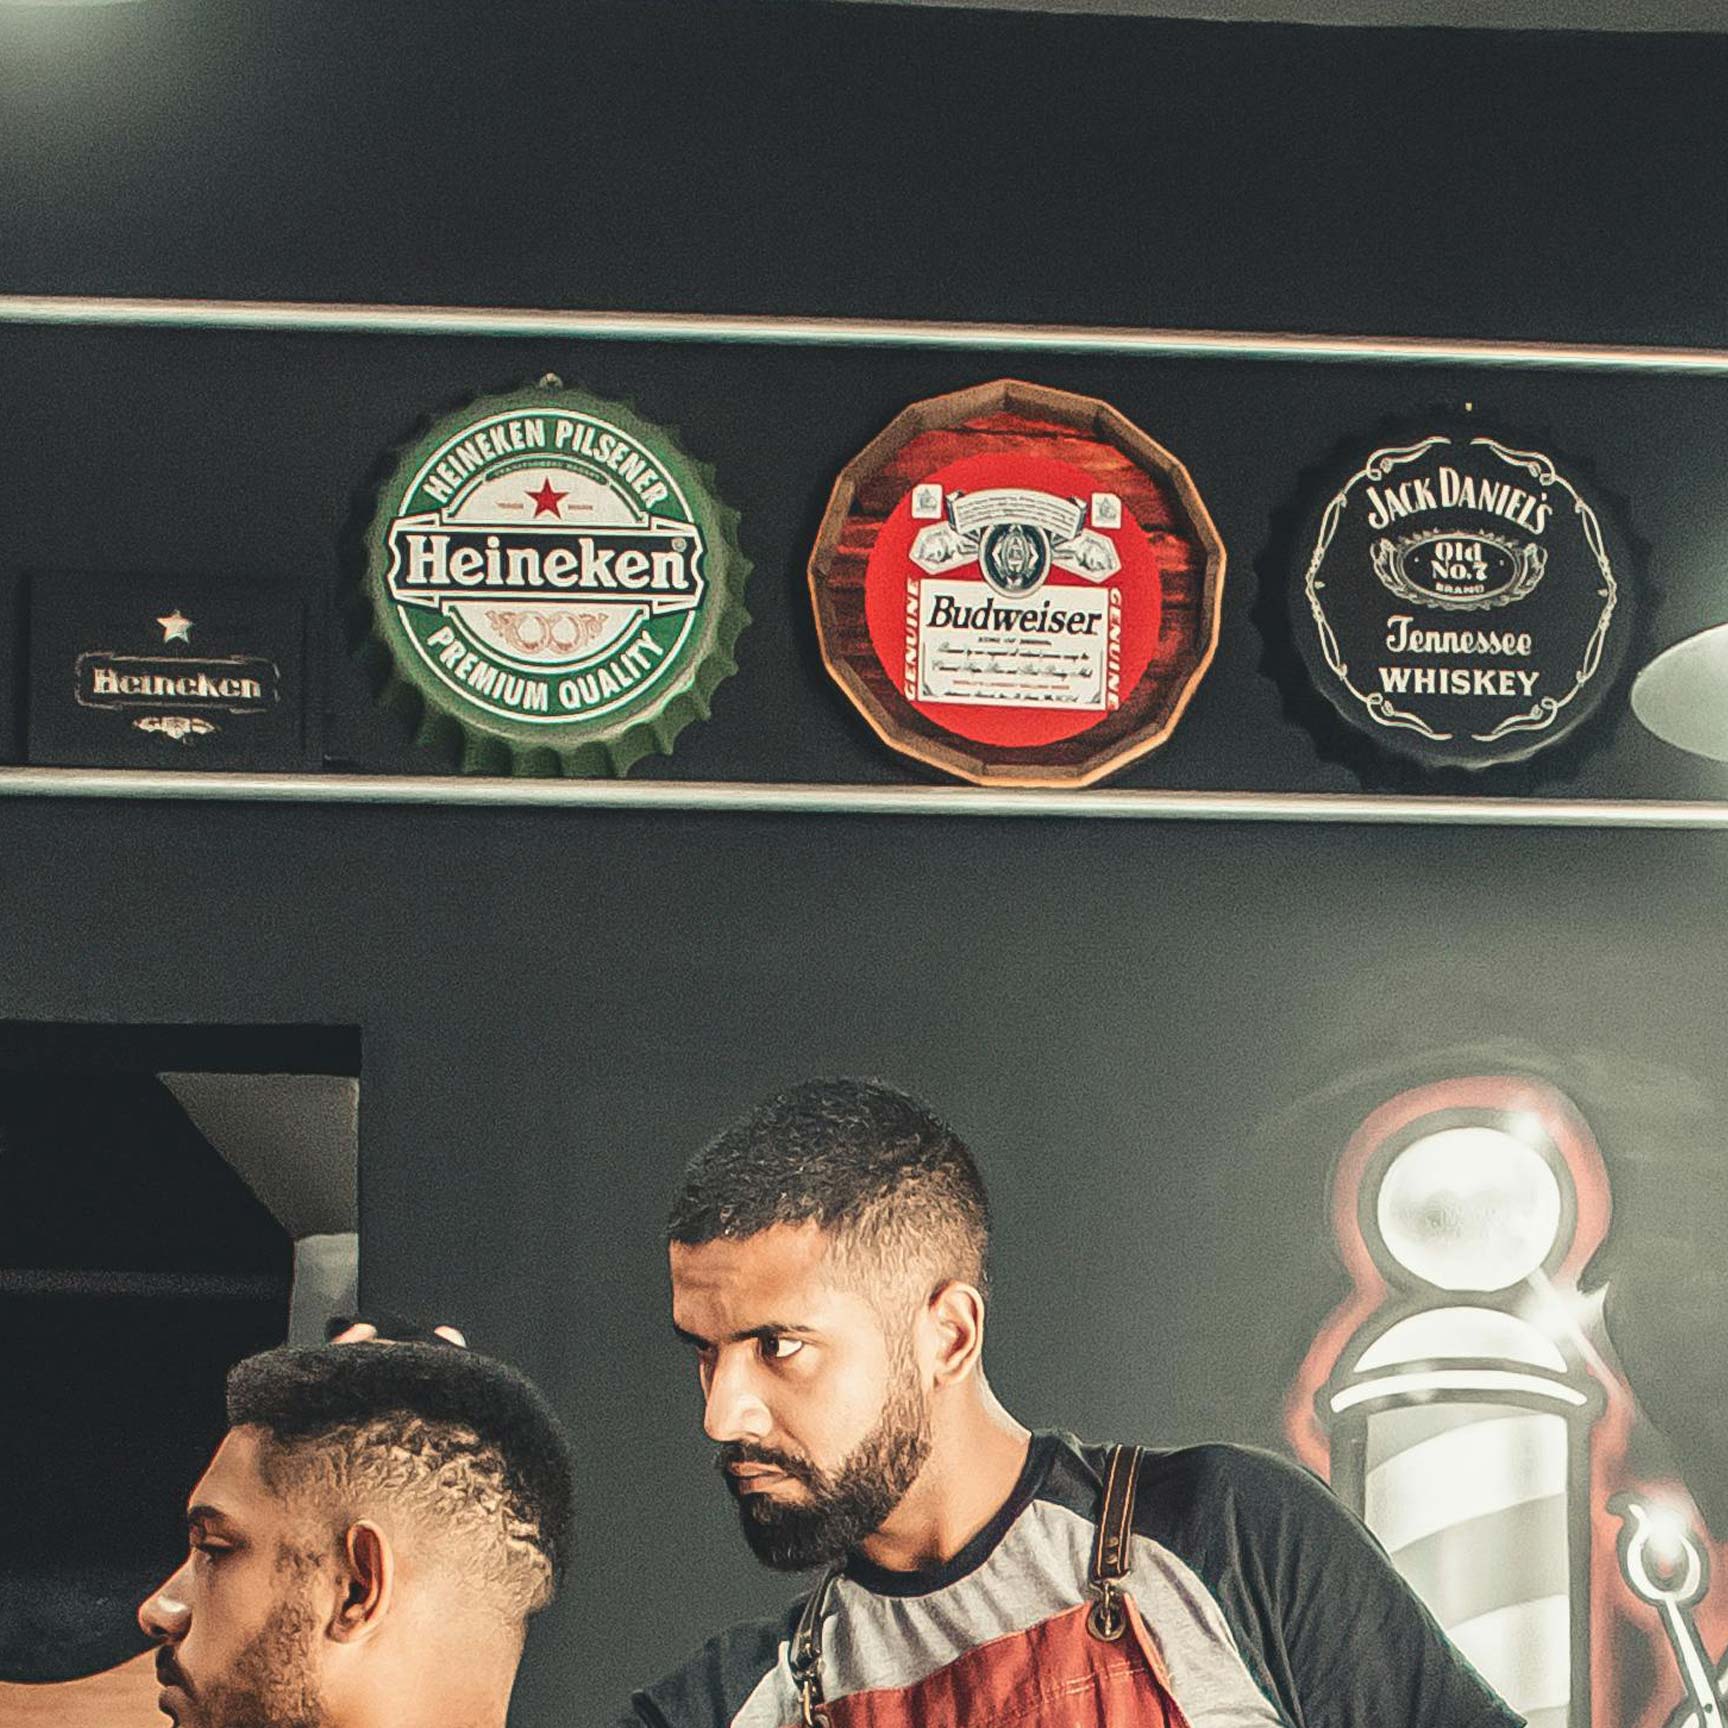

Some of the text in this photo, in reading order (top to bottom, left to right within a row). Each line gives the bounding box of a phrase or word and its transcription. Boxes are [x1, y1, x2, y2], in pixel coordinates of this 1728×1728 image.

[423, 418, 668, 508] HEINEKEN PILSENER
[1366, 478, 1437, 529] JACK
[406, 535, 689, 588] Heineken
[1435, 542, 1481, 562] Old
[1435, 582, 1485, 594] BRAND
[927, 594, 1102, 635] Budweiser
[1386, 614, 1532, 656] Tennessee
[904, 576, 919, 701] GENUINE
[1107, 587, 1121, 711] GENUINE
[92, 666, 262, 699] Heineken
[427, 626, 663, 711] PREMIUM QUALITY
[1379, 667, 1540, 697] WHISKEY
